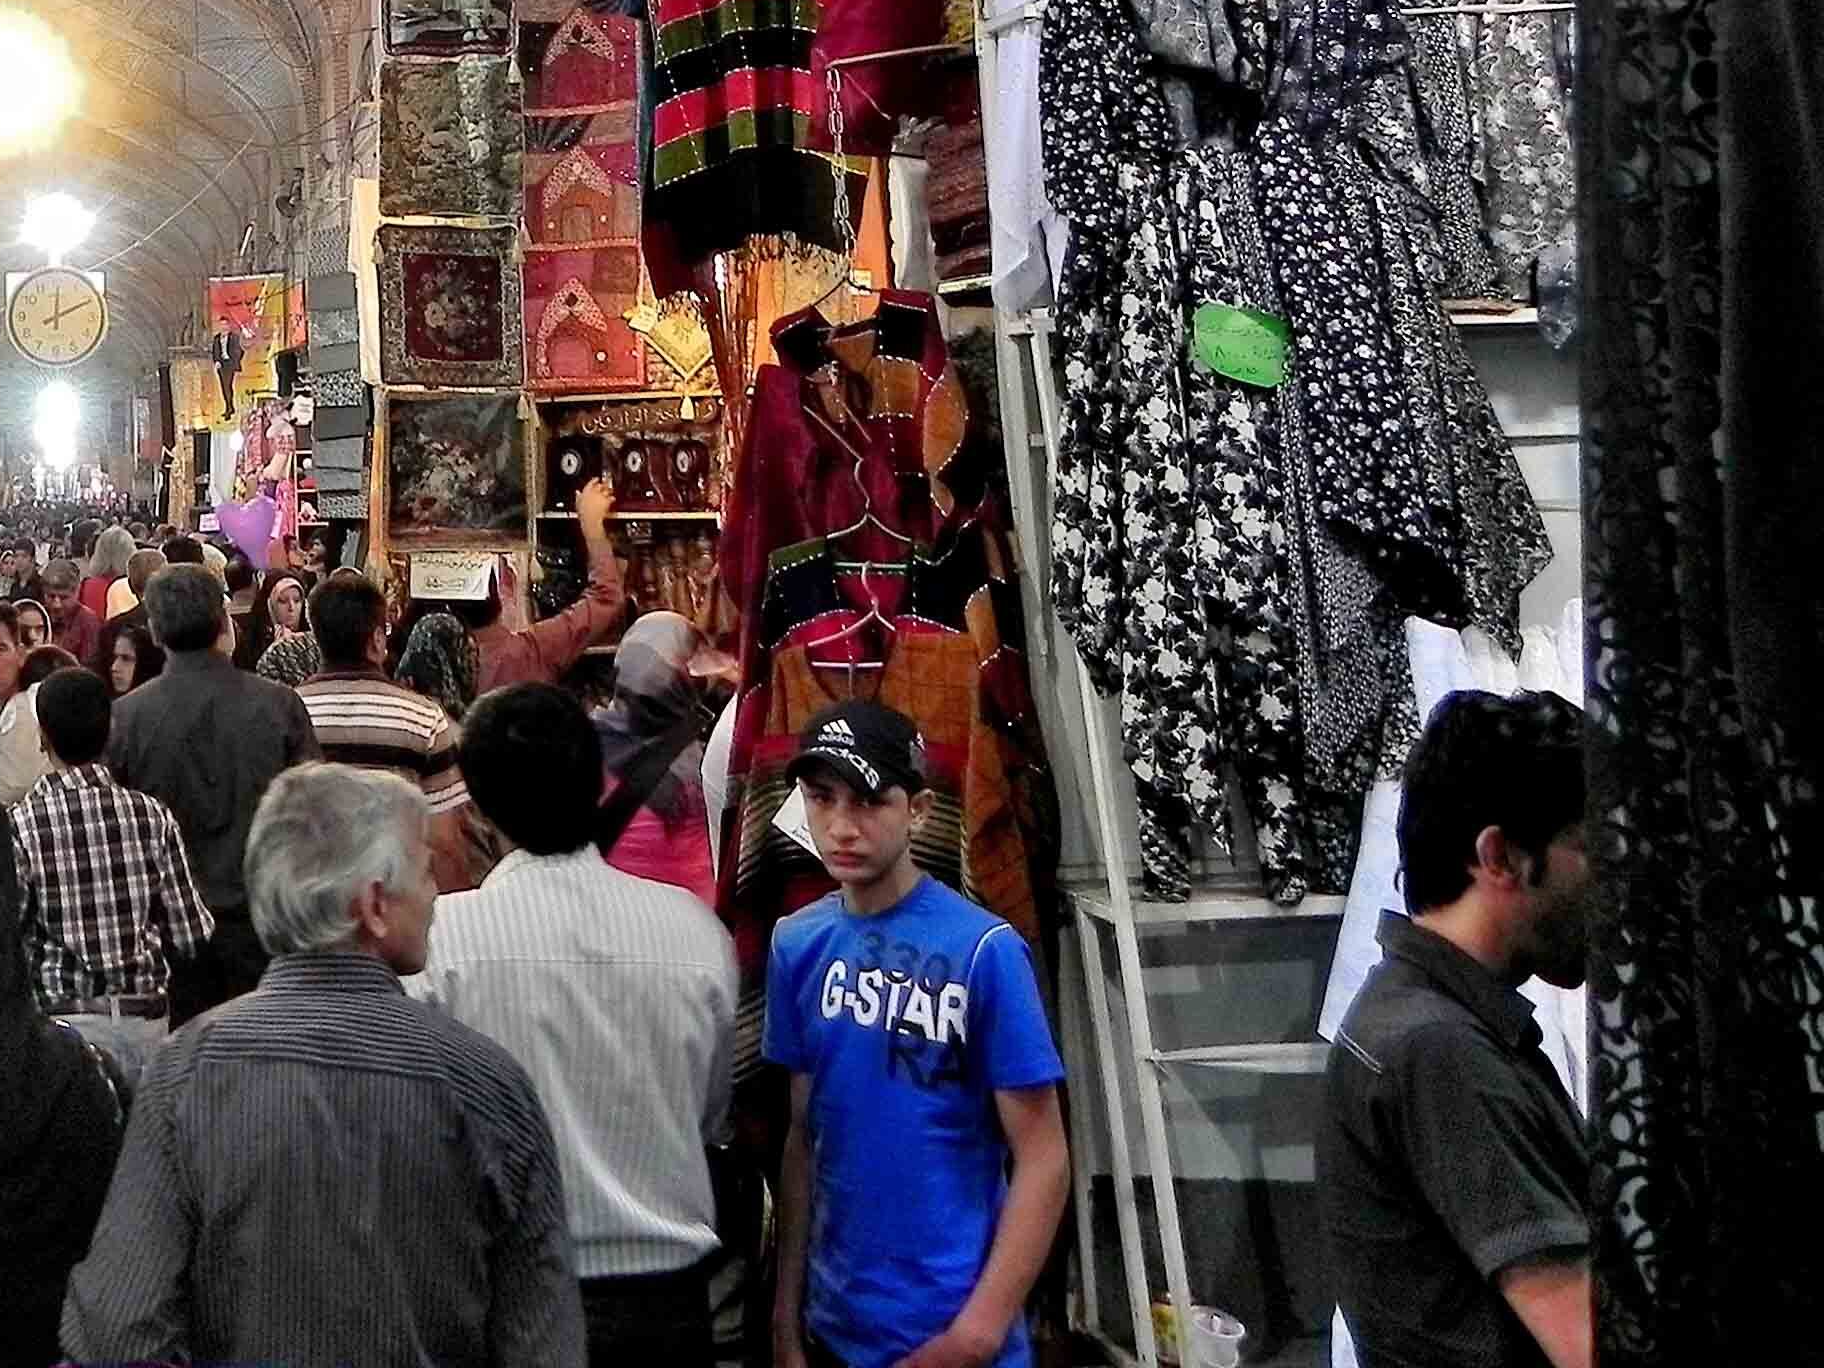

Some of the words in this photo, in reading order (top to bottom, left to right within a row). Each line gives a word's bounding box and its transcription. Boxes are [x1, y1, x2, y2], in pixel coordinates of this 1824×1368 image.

[24, 295, 38, 305] 10
[17, 311, 26, 322] 9
[821, 959, 969, 1047] G-STAR
